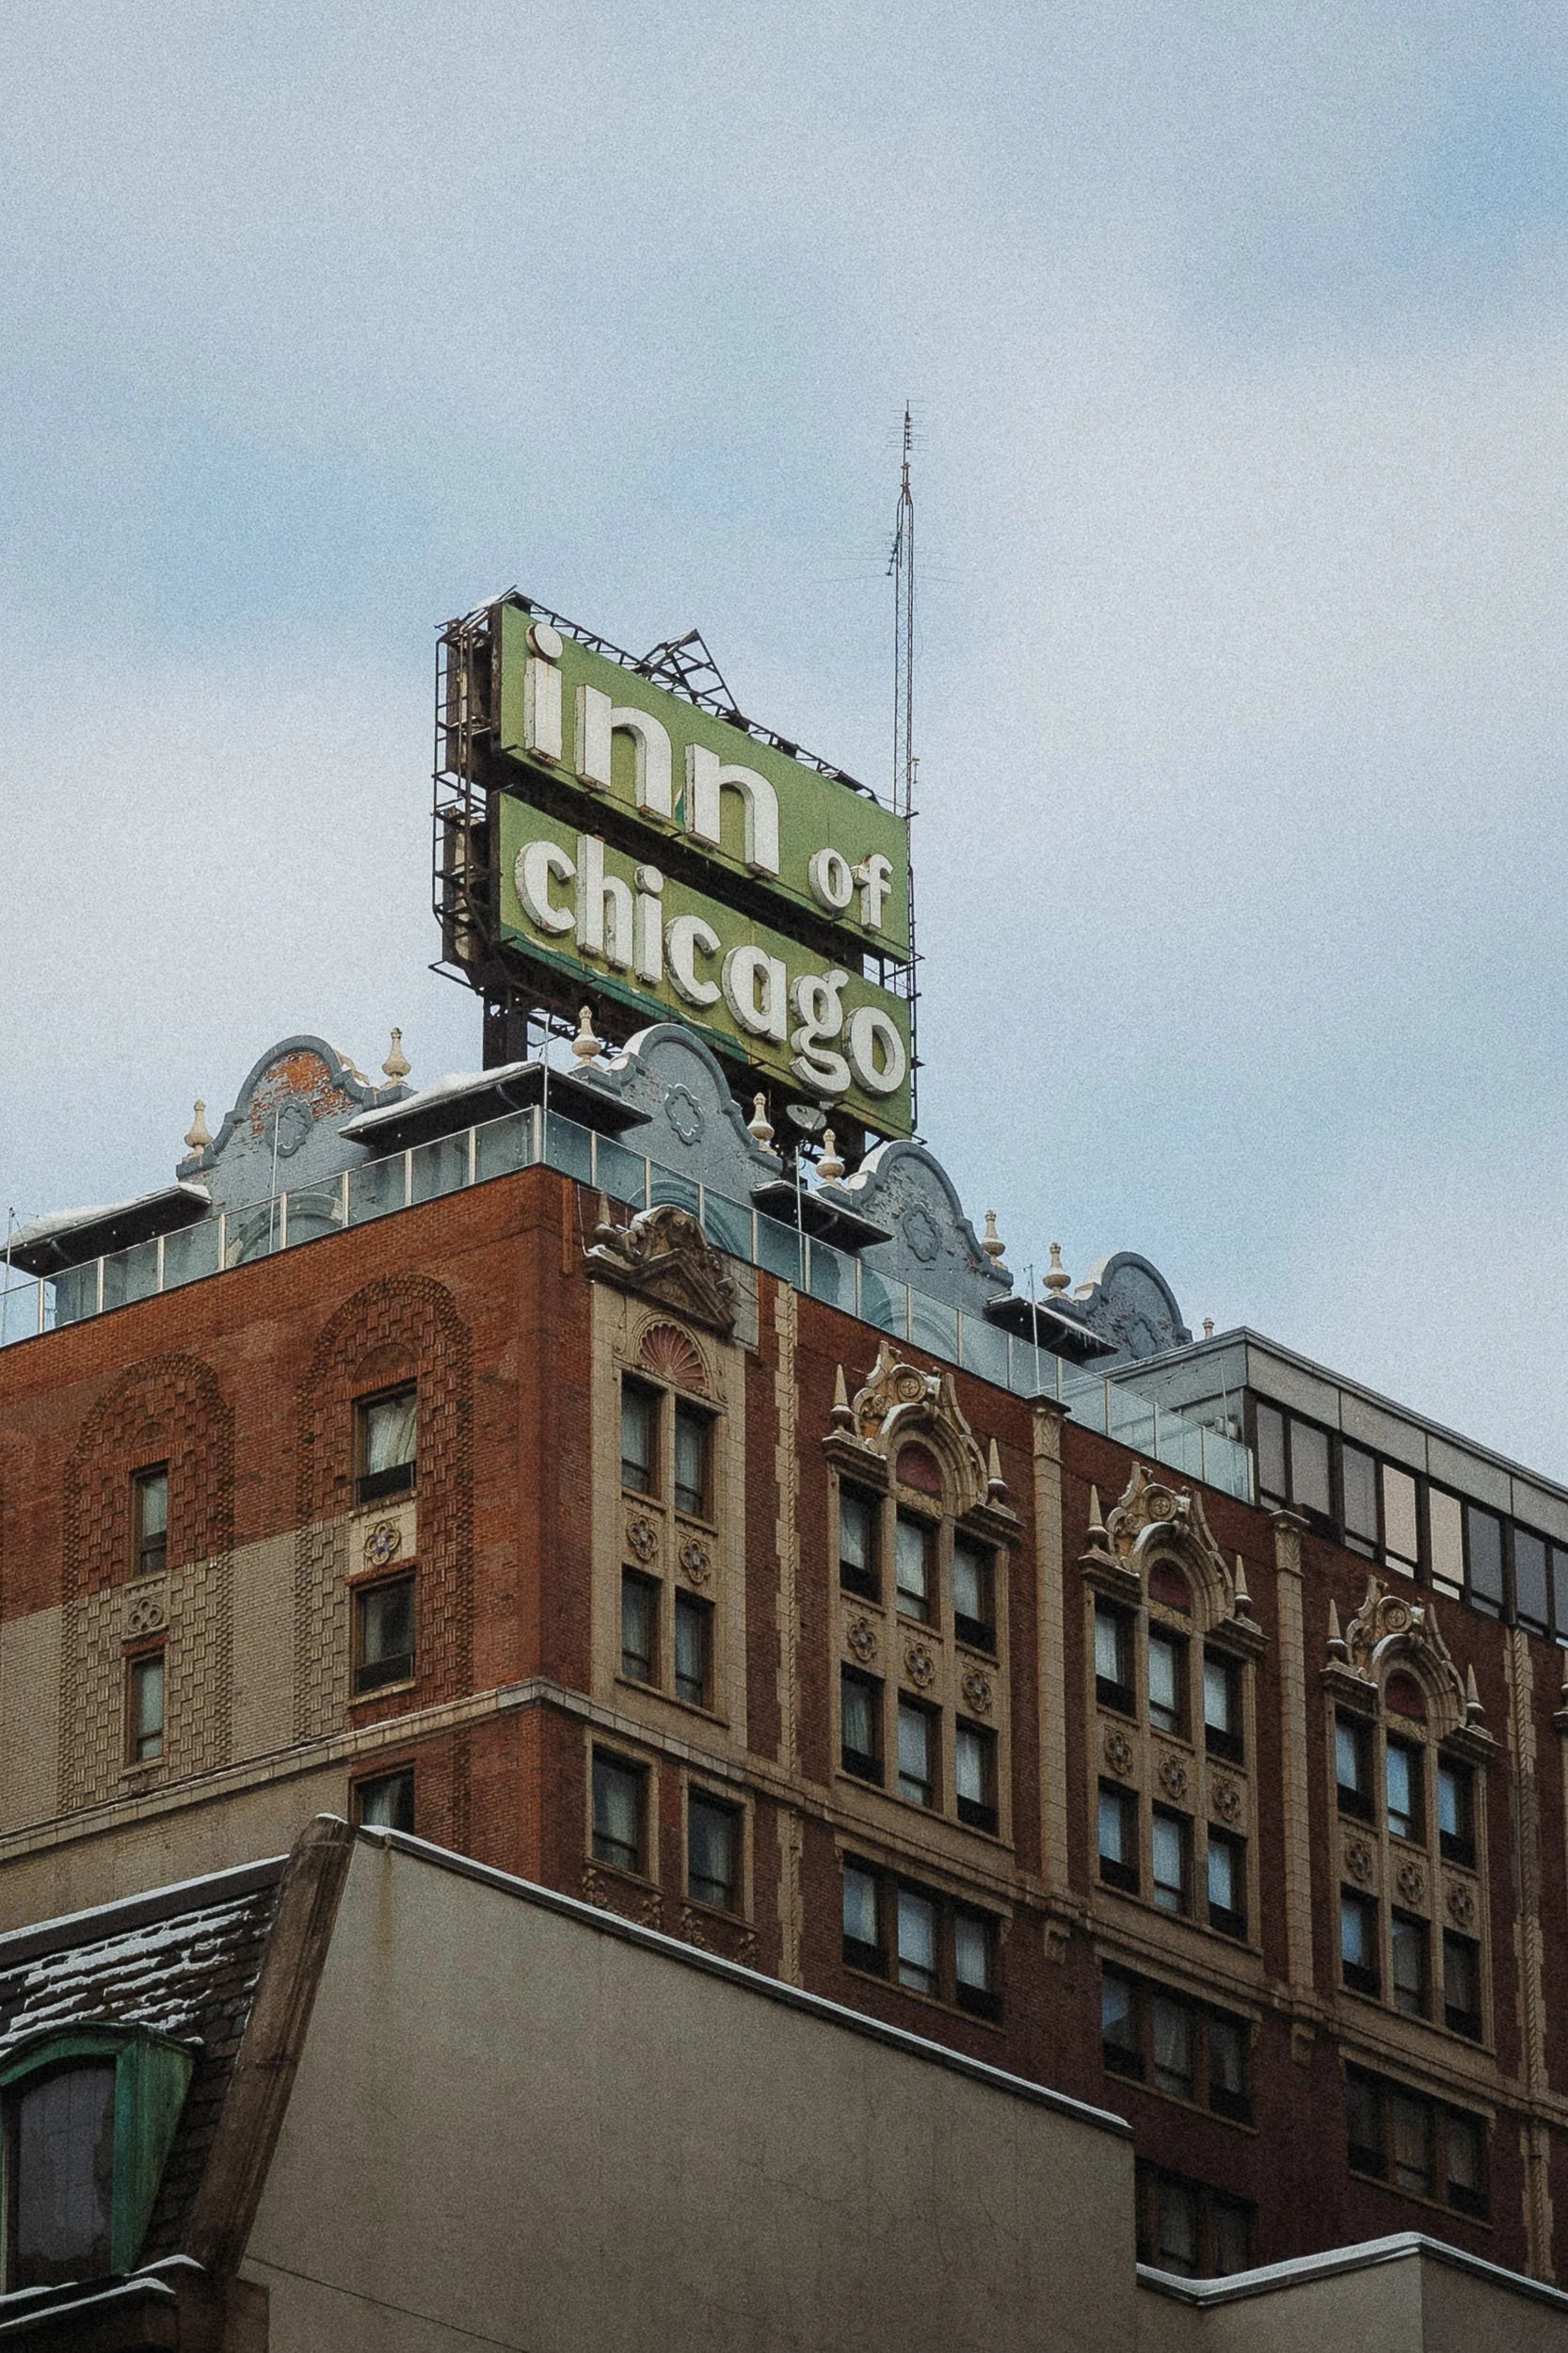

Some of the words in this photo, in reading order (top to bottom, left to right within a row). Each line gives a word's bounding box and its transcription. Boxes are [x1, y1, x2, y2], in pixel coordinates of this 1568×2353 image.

[523, 622, 779, 877] inn
[808, 847, 893, 930] of
[514, 833, 906, 1096] chicago
